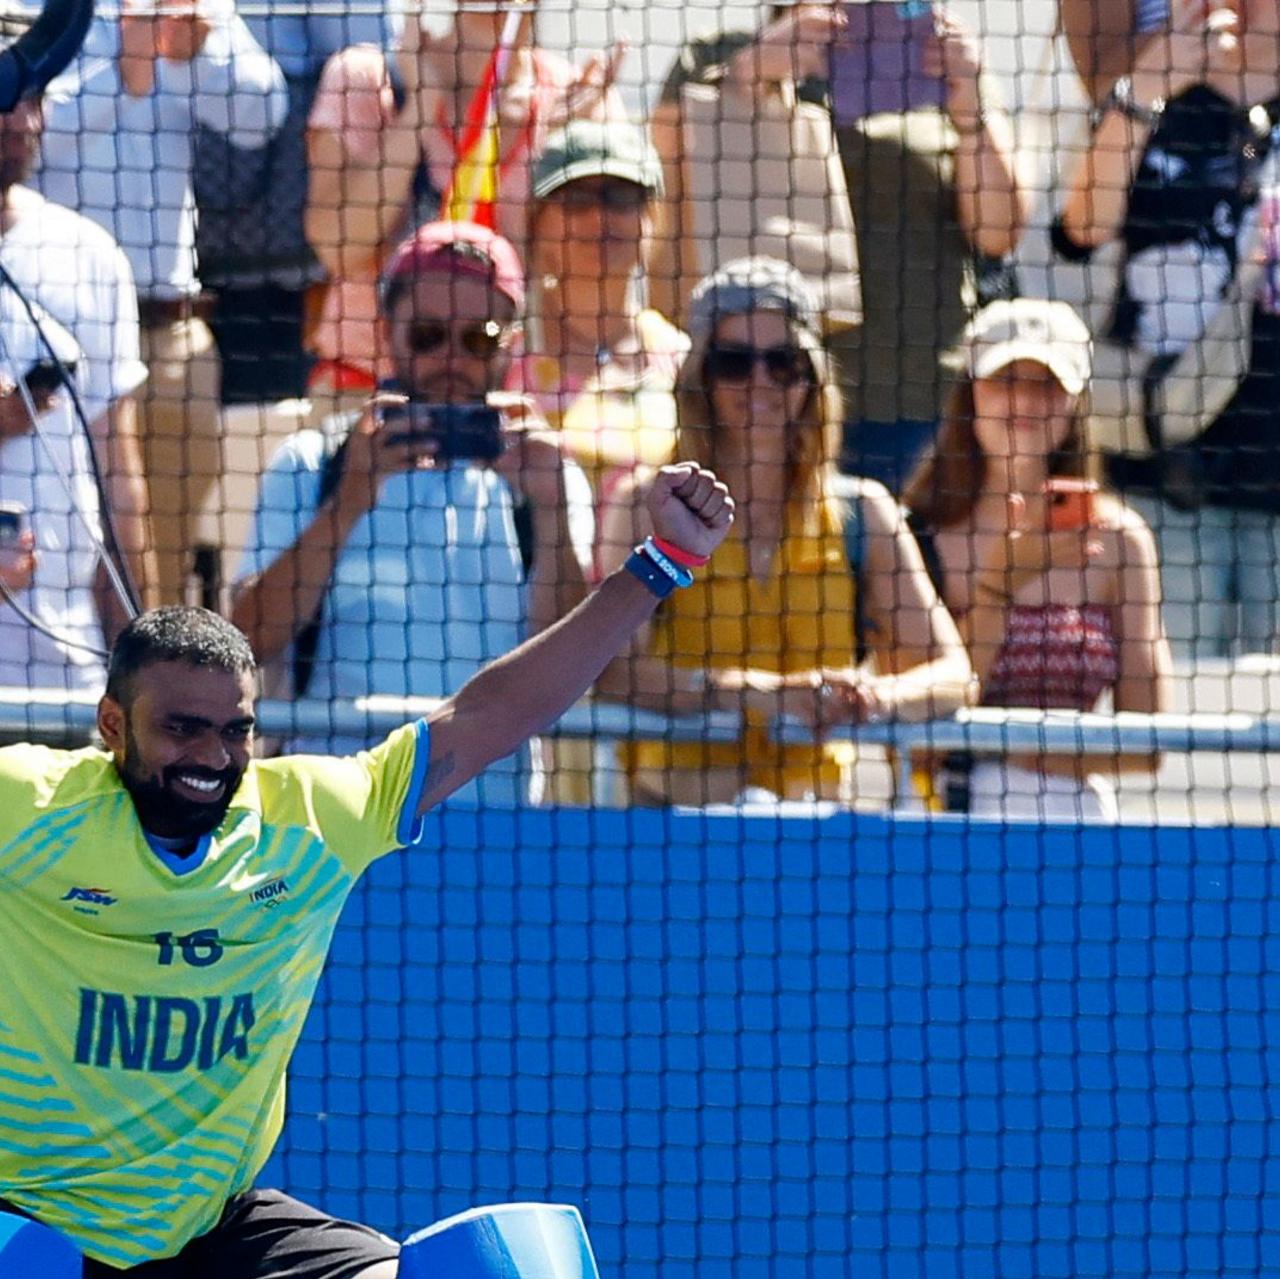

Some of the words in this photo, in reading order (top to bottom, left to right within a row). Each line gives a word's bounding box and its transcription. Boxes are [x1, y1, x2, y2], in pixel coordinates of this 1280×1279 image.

[249, 880, 289, 903] INDIA
[152, 929, 224, 967] 16
[74, 987, 256, 1074] INDIA
